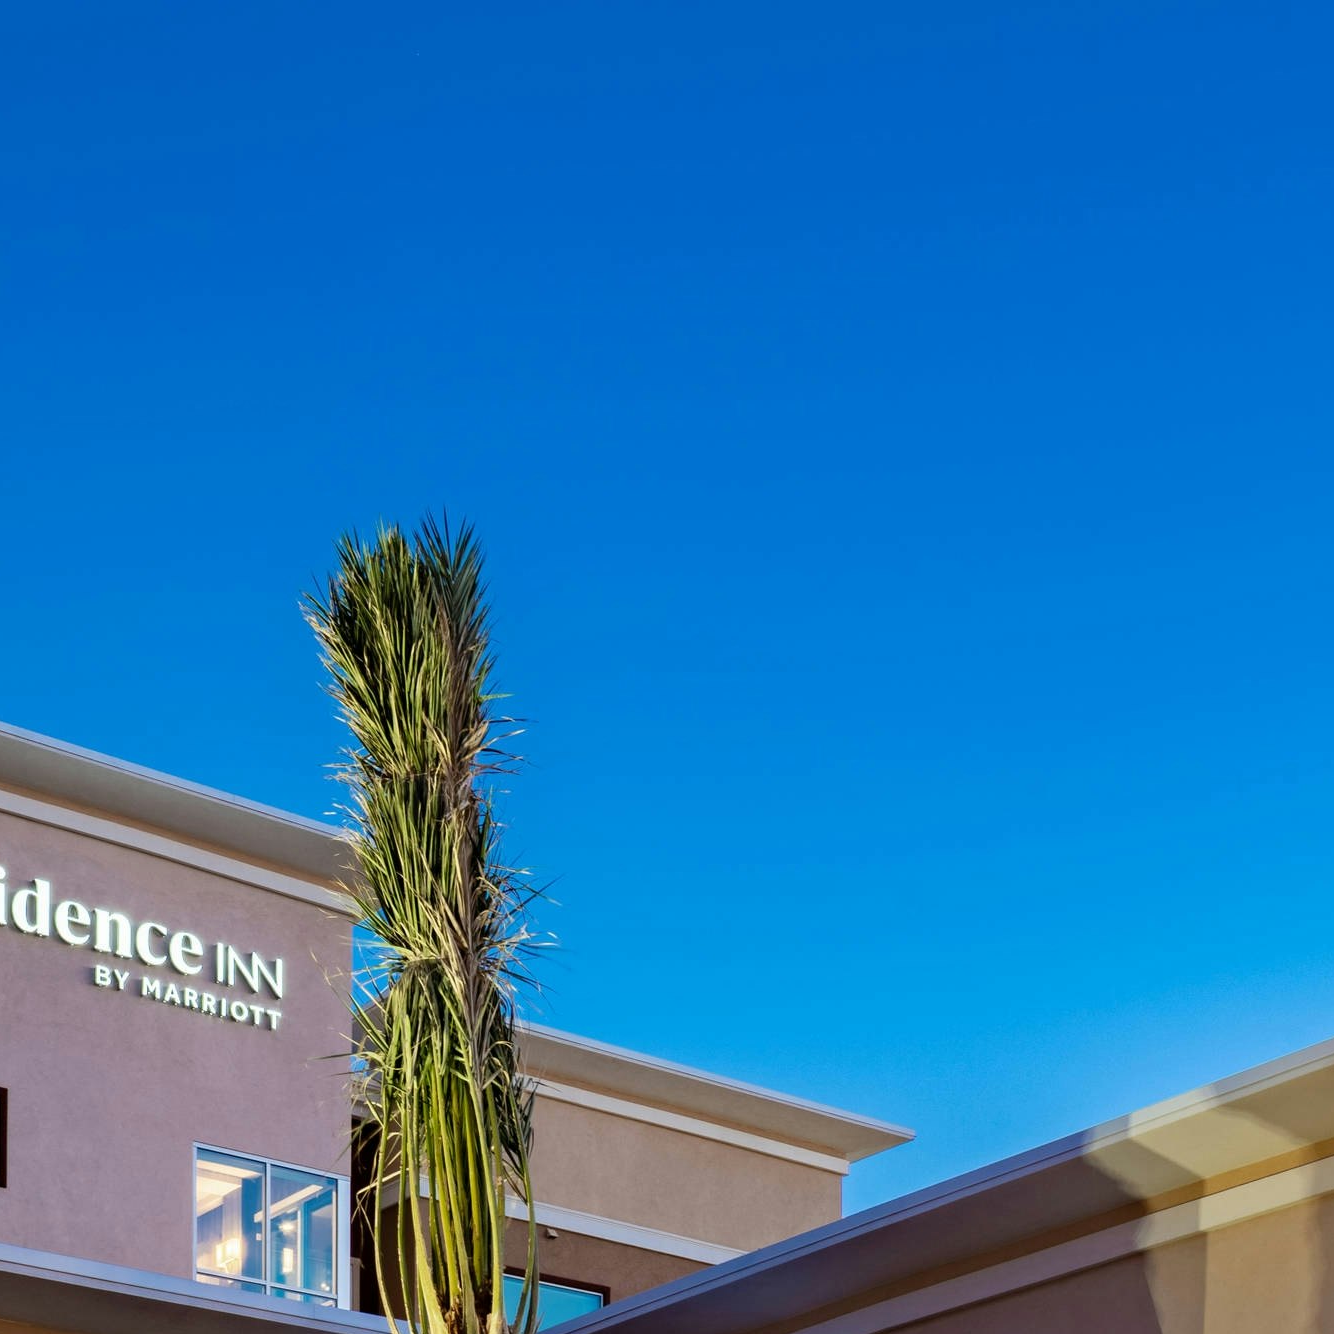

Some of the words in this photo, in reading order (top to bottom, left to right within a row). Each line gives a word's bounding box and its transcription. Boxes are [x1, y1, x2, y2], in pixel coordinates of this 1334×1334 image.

[94, 964, 130, 991] BY
[141, 976, 283, 1031] MARRIOTT
[216, 942, 284, 999] INN
